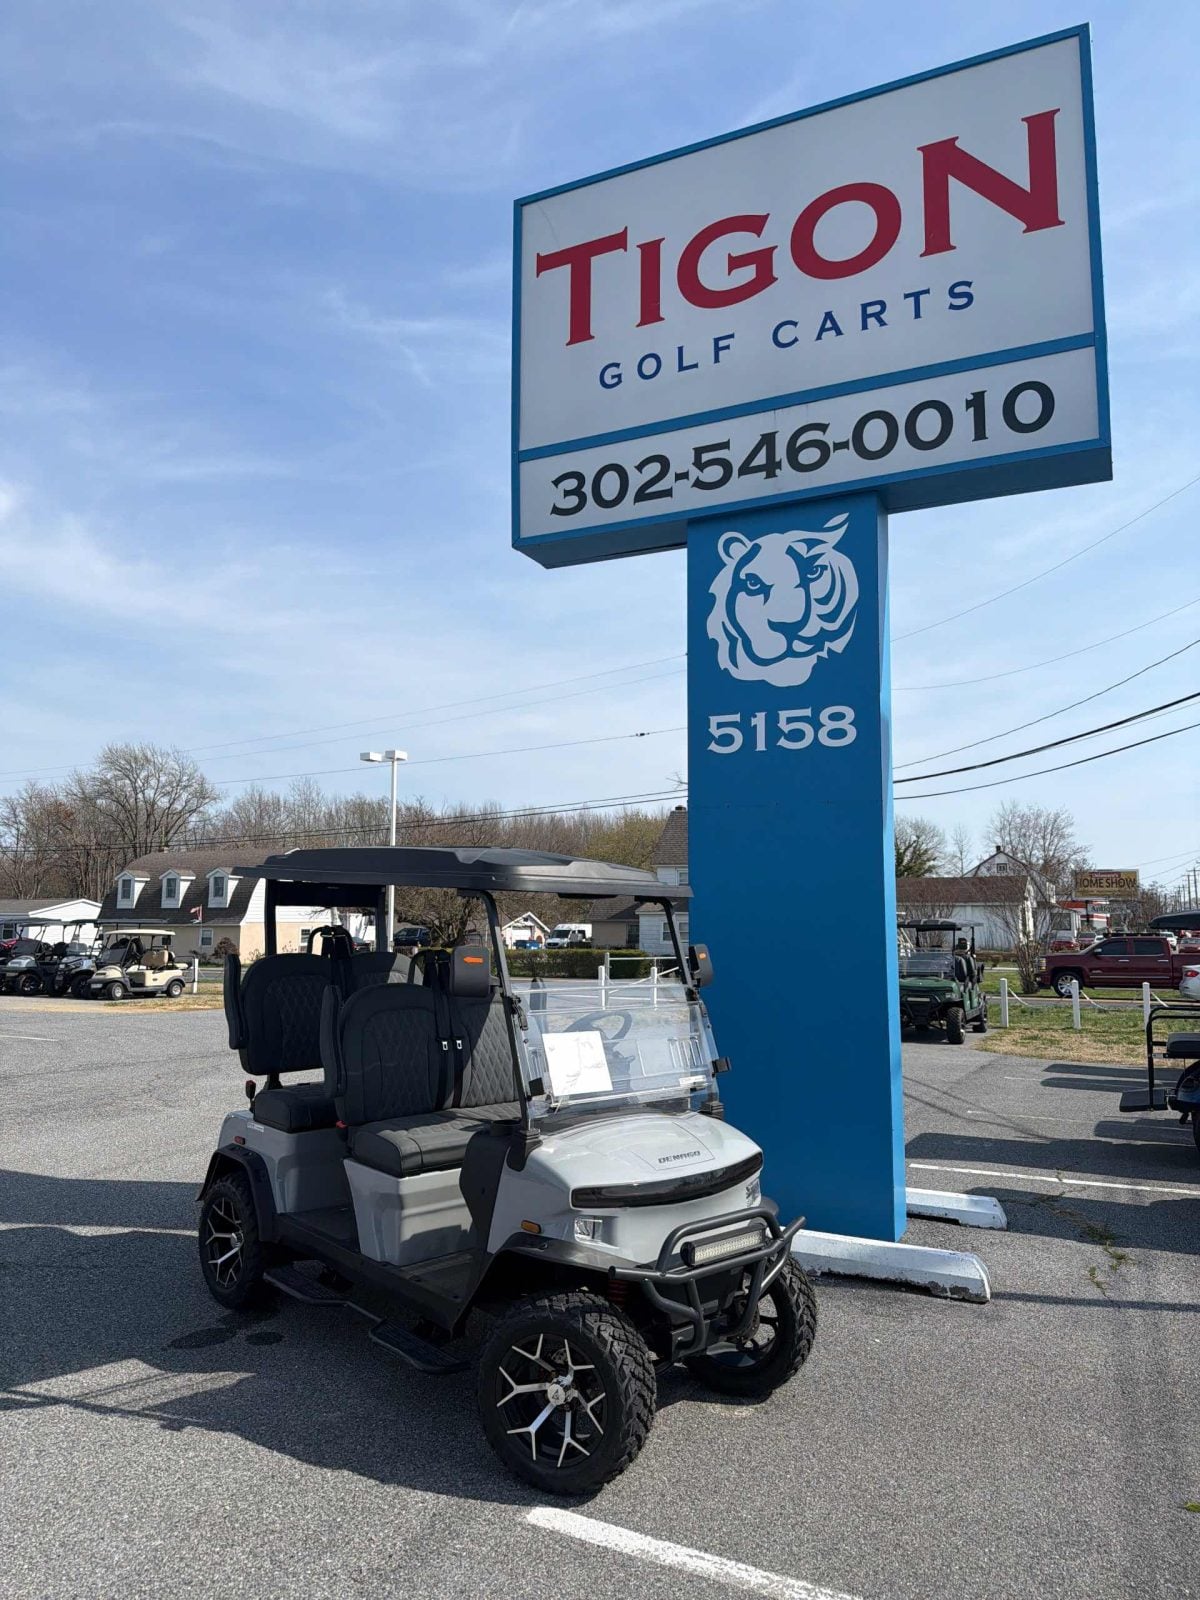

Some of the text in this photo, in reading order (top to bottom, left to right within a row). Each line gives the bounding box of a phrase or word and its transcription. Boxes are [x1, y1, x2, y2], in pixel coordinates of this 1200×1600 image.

[536, 108, 1065, 346] TIGON
[598, 280, 975, 390] GOLF CARTS
[549, 380, 1056, 517] 302-546-0010
[707, 705, 857, 754] 5158
[1076, 877, 1137, 889] HOME SHOW
